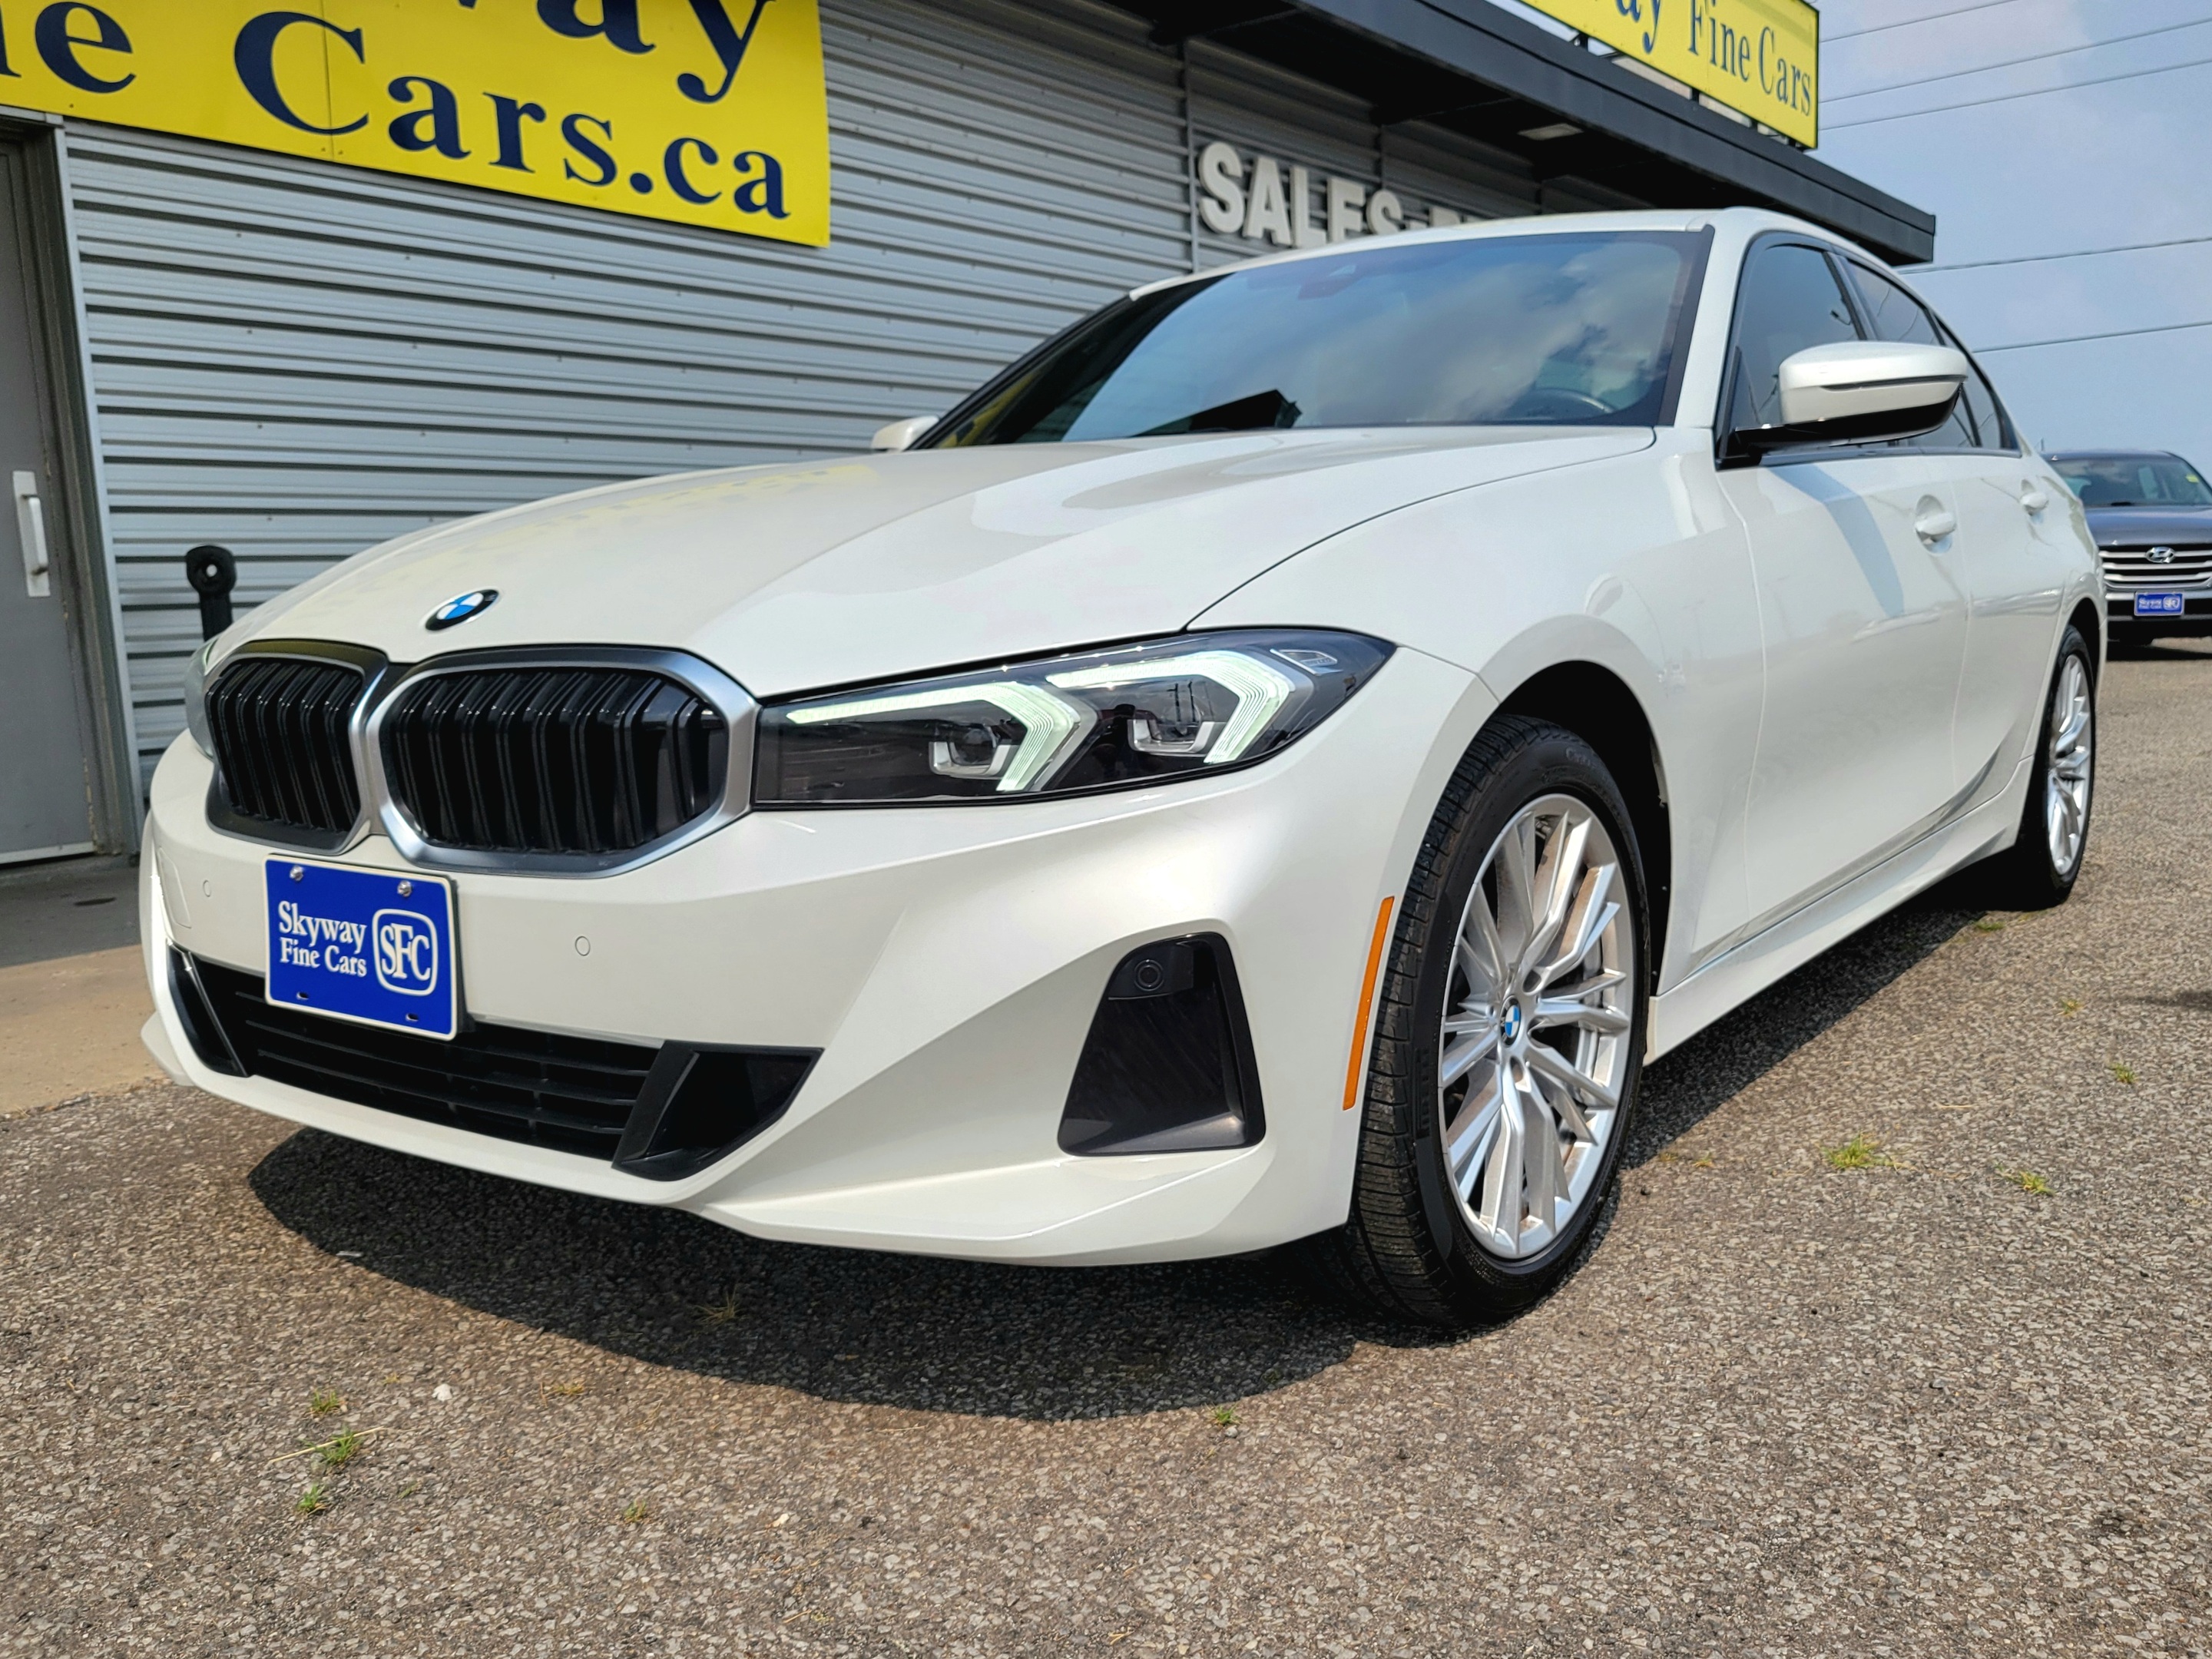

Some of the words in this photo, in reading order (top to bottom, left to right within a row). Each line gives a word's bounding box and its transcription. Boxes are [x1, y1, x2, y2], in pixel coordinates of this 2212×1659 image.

[459, 0, 775, 104] ay
[1687, 0, 1750, 82] Fine
[1759, 26, 1811, 118] Cars
[0, 0, 137, 94] e
[233, 10, 790, 219] Cars.ca
[277, 900, 367, 954] Skyway
[280, 937, 320, 968] Fine
[324, 945, 367, 977] Cars
[379, 922, 431, 982] SFC
